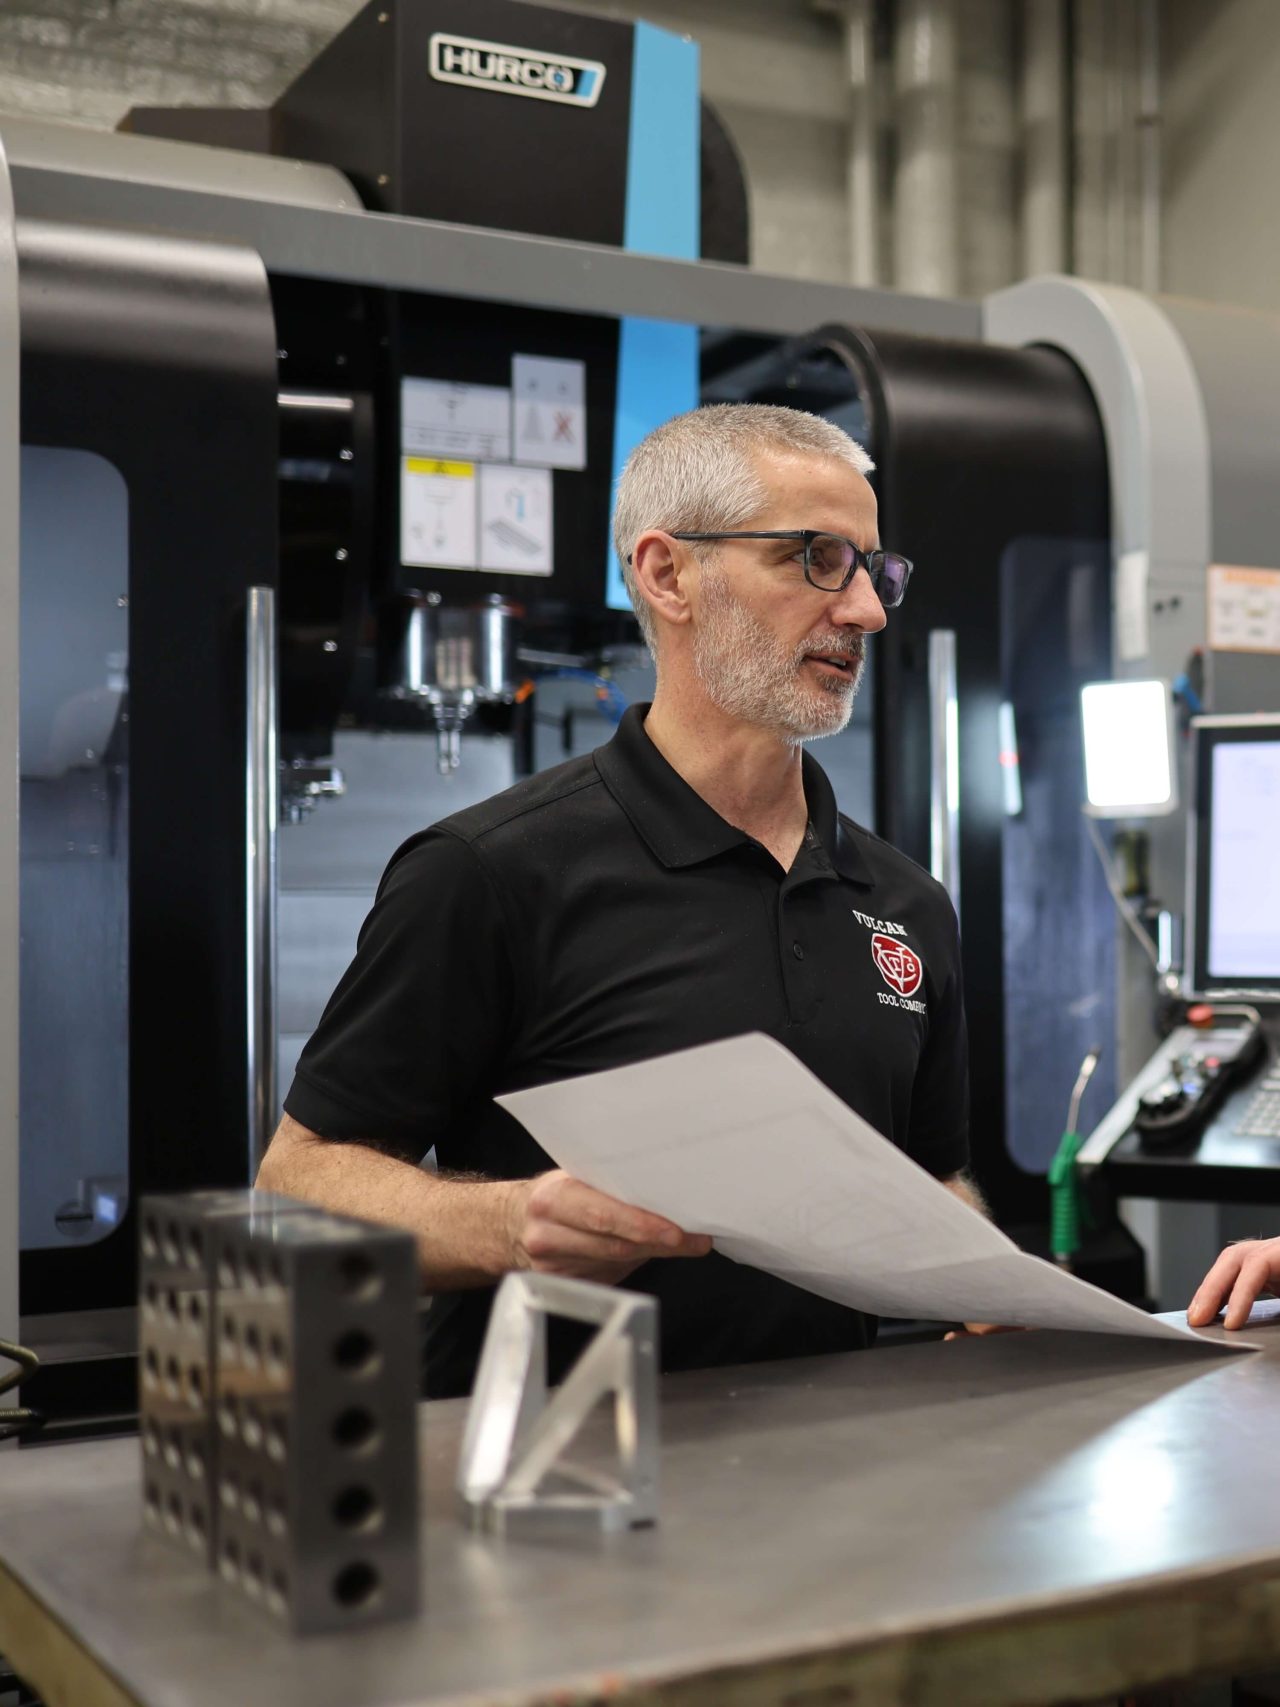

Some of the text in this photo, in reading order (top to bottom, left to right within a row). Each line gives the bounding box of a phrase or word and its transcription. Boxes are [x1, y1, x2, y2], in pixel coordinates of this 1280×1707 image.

[443, 45, 574, 93] HURCO
[852, 909, 908, 936] VULCAN
[876, 992, 900, 1007] TOOL
